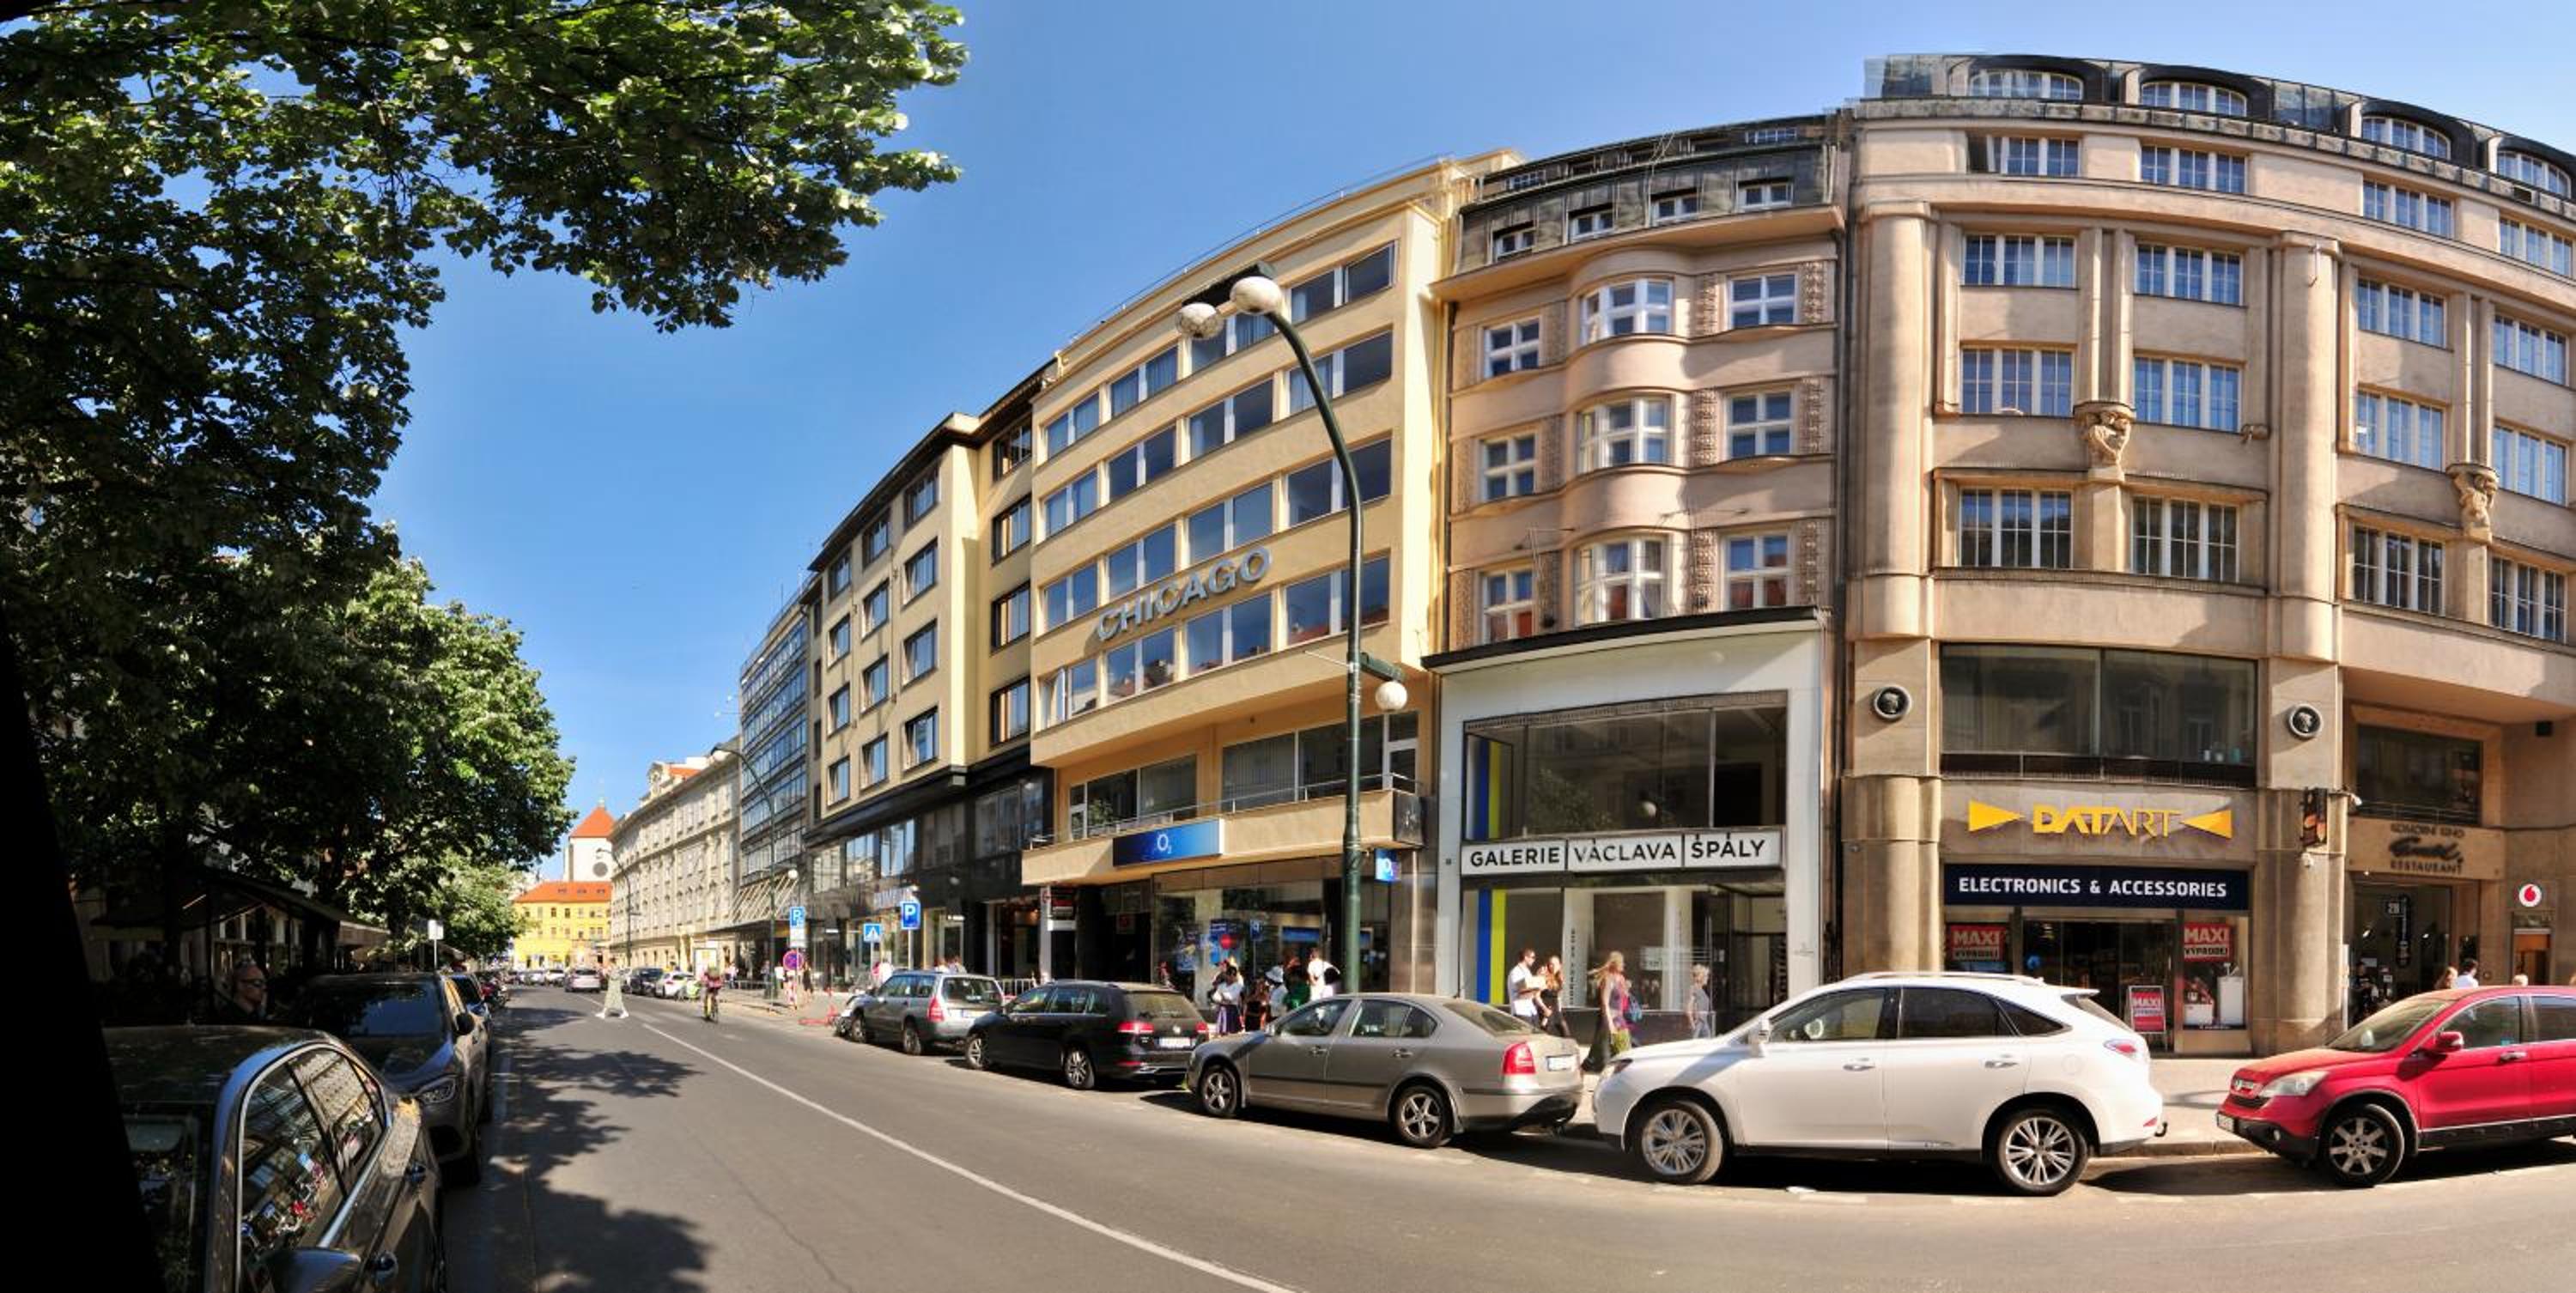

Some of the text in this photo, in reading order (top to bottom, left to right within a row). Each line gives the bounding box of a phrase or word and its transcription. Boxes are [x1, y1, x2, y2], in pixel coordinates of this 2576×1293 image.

[1097, 545, 1273, 642] CHICAGO
[2032, 805, 2181, 837] DATART
[1470, 846, 1561, 867] GALERIE
[1958, 877, 2227, 898] ELECTRONICS & ACCESSORIES
[904, 904, 916, 920] P
[1953, 930, 2001, 945] MAXI
[2184, 927, 2229, 944] MAXI
